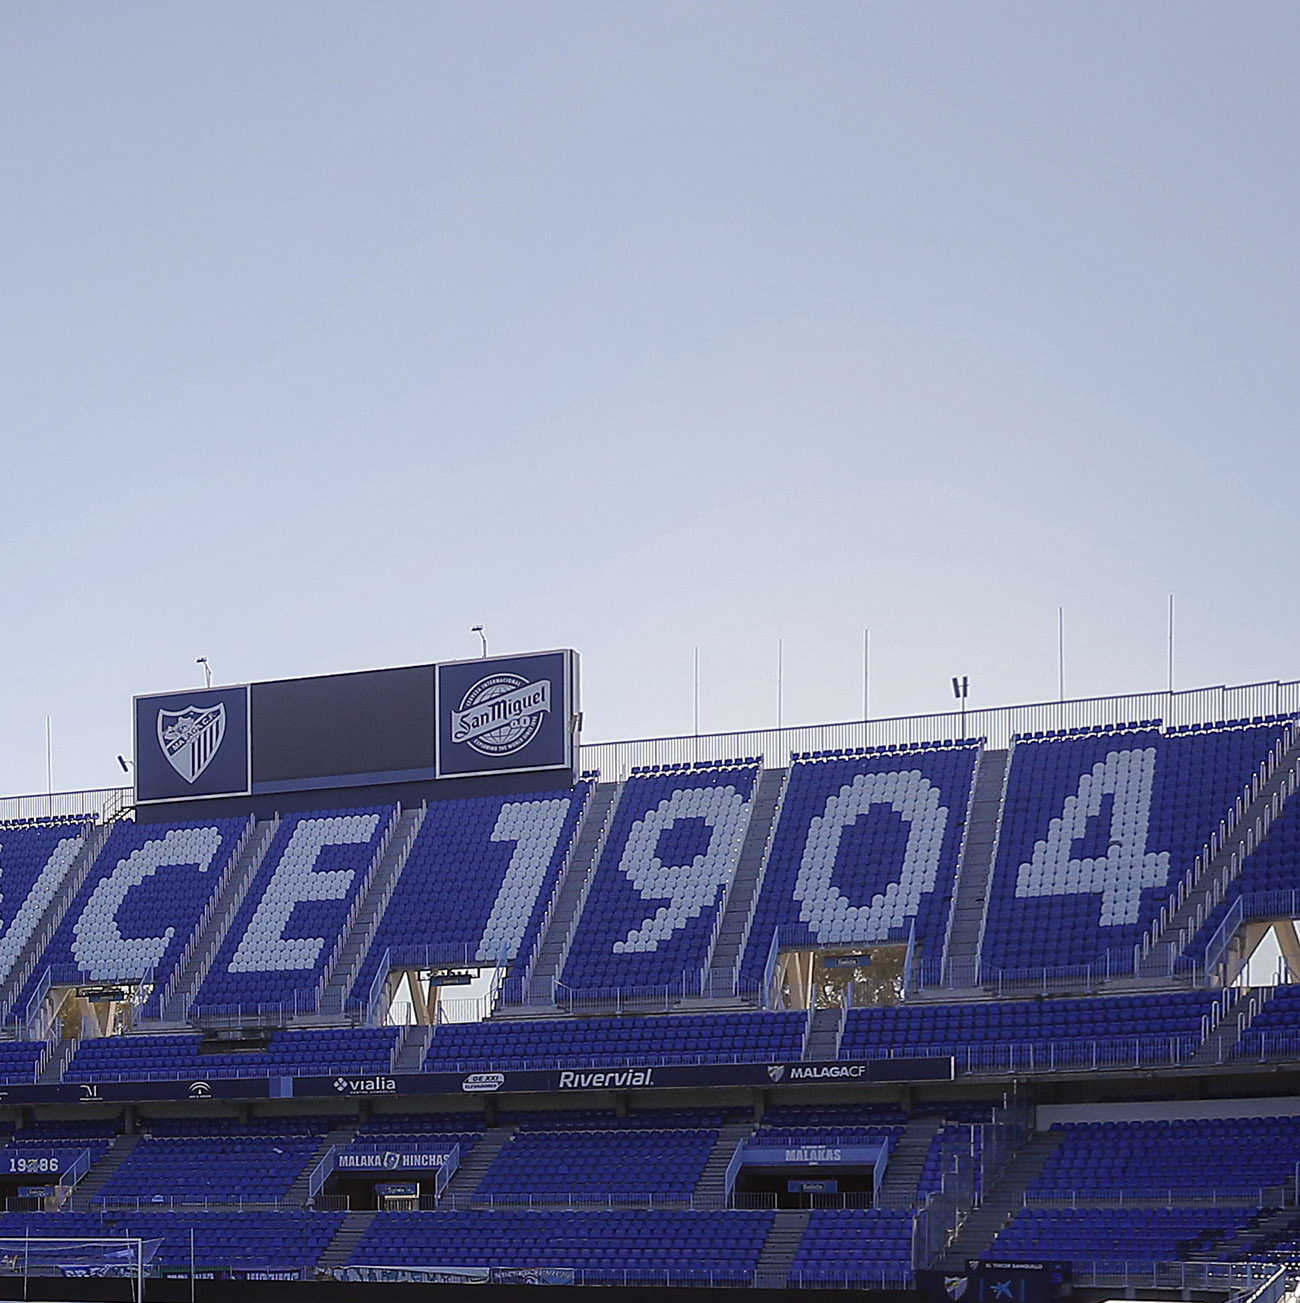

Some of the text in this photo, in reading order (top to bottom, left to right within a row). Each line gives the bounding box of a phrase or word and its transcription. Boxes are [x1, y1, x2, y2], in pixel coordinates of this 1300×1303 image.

[475, 747, 1170, 961] 1904
[349, 1076, 396, 1090] vialia
[339, 1155, 382, 1167] MALAKA
[785, 1148, 841, 1161] MALAKAS
